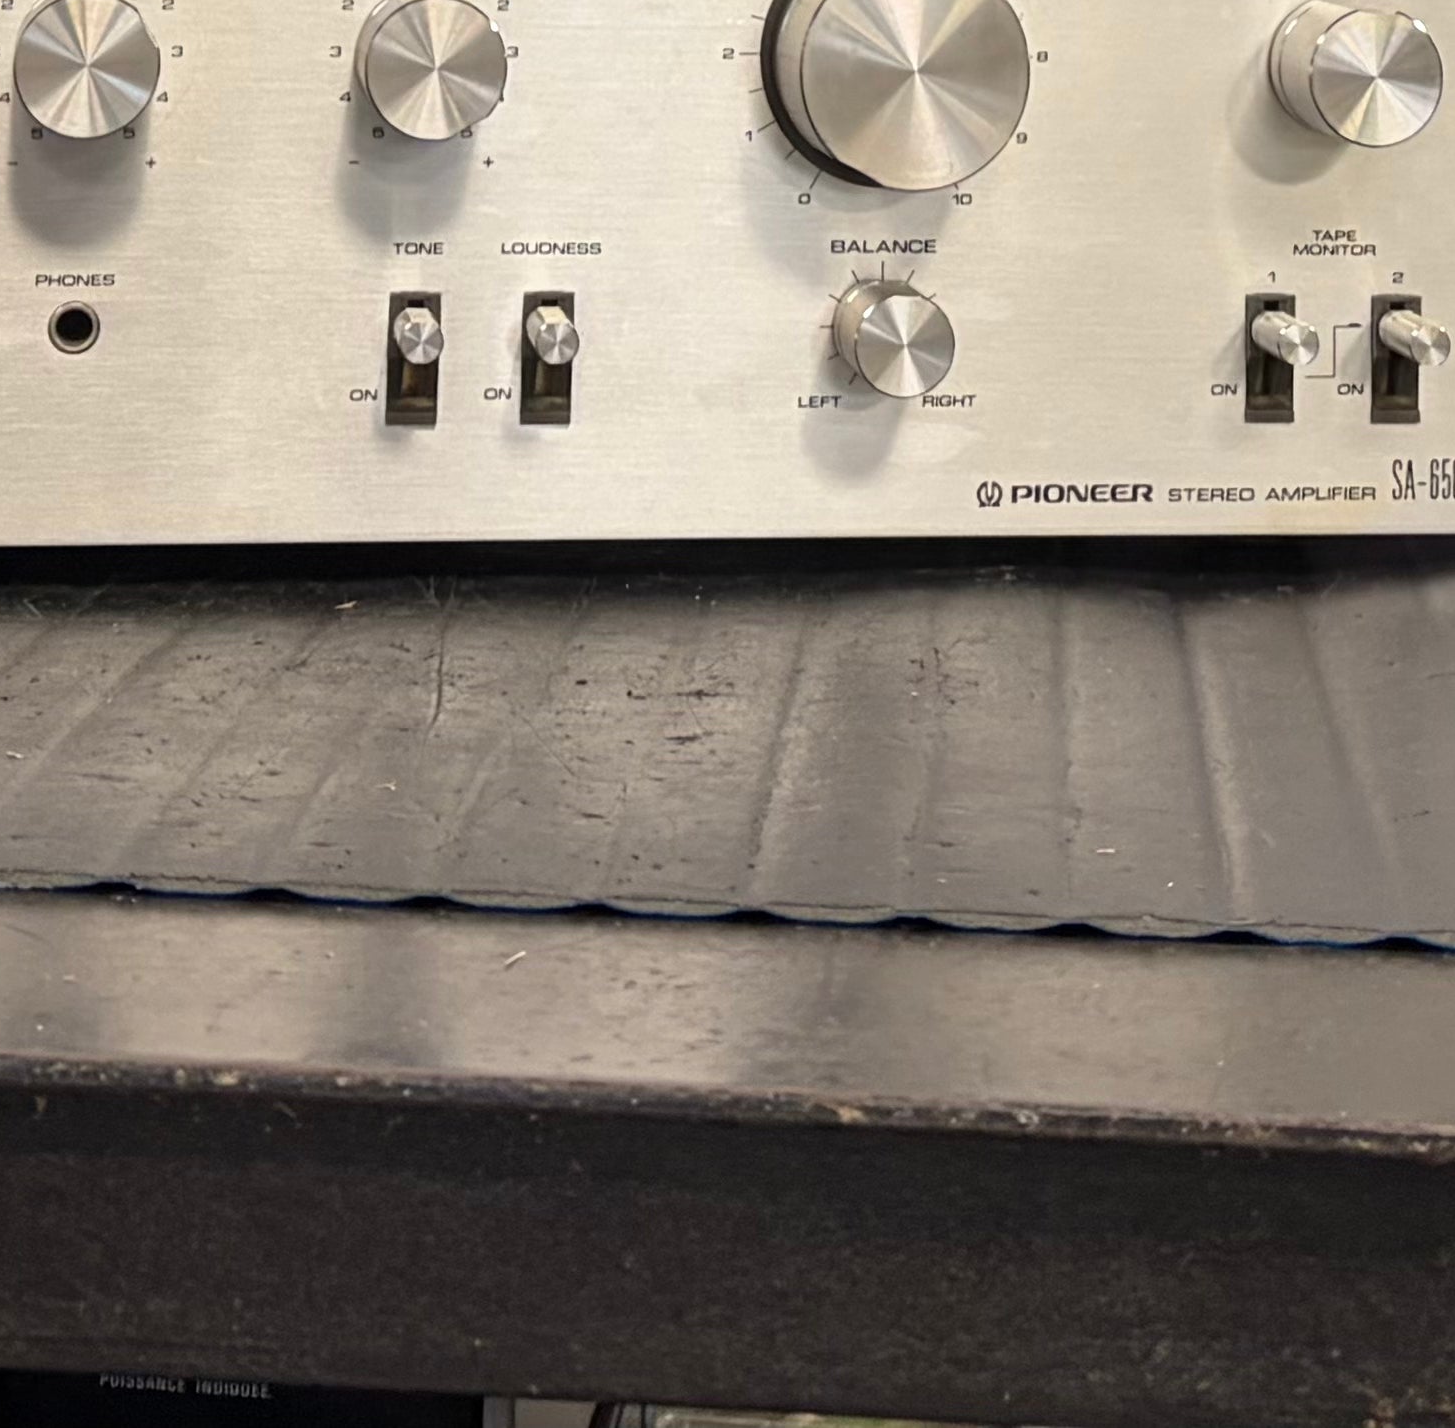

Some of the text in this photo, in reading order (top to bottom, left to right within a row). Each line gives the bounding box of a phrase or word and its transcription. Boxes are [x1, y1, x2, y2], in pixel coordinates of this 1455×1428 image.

[496, 0, 510, 12] 2
[171, 45, 184, 58] 3
[329, 45, 342, 58] 3
[505, 45, 519, 58] 3
[722, 47, 735, 60] 2
[1036, 50, 1049, 63] 8
[156, 91, 169, 103] 4
[339, 91, 352, 103] 4
[745, 129, 753, 142] 1
[1015, 132, 1028, 144] 9
[952, 193, 973, 205] 10
[1312, 229, 1357, 242] TAPE
[393, 241, 444, 256] TONE
[500, 241, 602, 256] LOUDNESS
[829, 238, 937, 254] BALANCE
[1292, 243, 1377, 257] MONITOR
[35, 273, 116, 287] PHONES
[1268, 271, 1277, 284] 1
[1391, 271, 1404, 284] 2
[349, 388, 379, 402] ON
[483, 387, 512, 401] ON
[1210, 383, 1238, 397] ON
[1337, 383, 1365, 396] ON
[797, 395, 842, 409] LEFT
[921, 394, 976, 409] RIGHT
[1010, 483, 1153, 503] PIONEER
[1167, 487, 1255, 503] STEREO
[1265, 485, 1377, 502] AMPLIFIER
[99, 1373, 186, 1393] PUISSANCE
